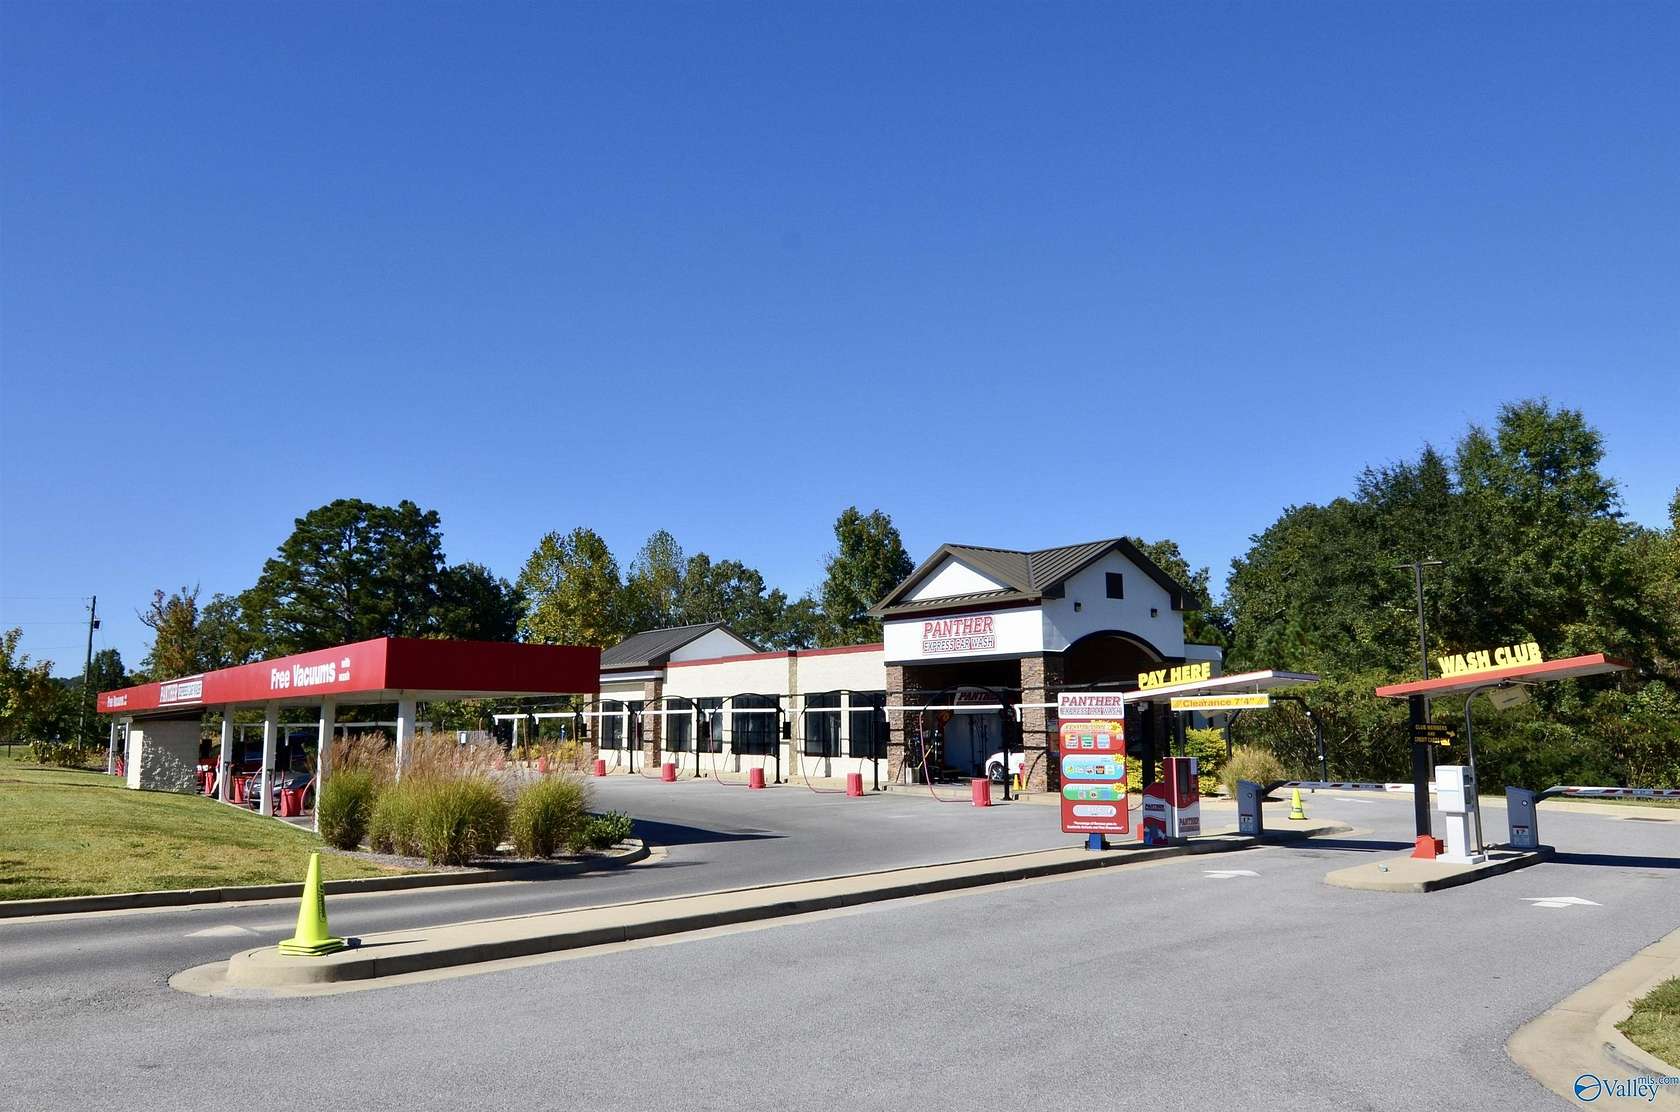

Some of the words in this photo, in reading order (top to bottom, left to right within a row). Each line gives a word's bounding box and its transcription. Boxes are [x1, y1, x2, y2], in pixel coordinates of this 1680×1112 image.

[923, 616, 993, 639] PANTHER
[923, 639, 955, 652] EXPRESS
[956, 638, 970, 650] CAR
[971, 635, 994, 649] WASH
[1438, 650, 1491, 677] WASH
[1494, 643, 1542, 666] CLUB
[270, 668, 290, 689] Free
[293, 662, 336, 687] Vacuums
[1138, 669, 1166, 690] PAY
[1170, 662, 1210, 685] HERE
[1061, 696, 1121, 707] PANTHER
[1183, 699, 1232, 708] Clearance
